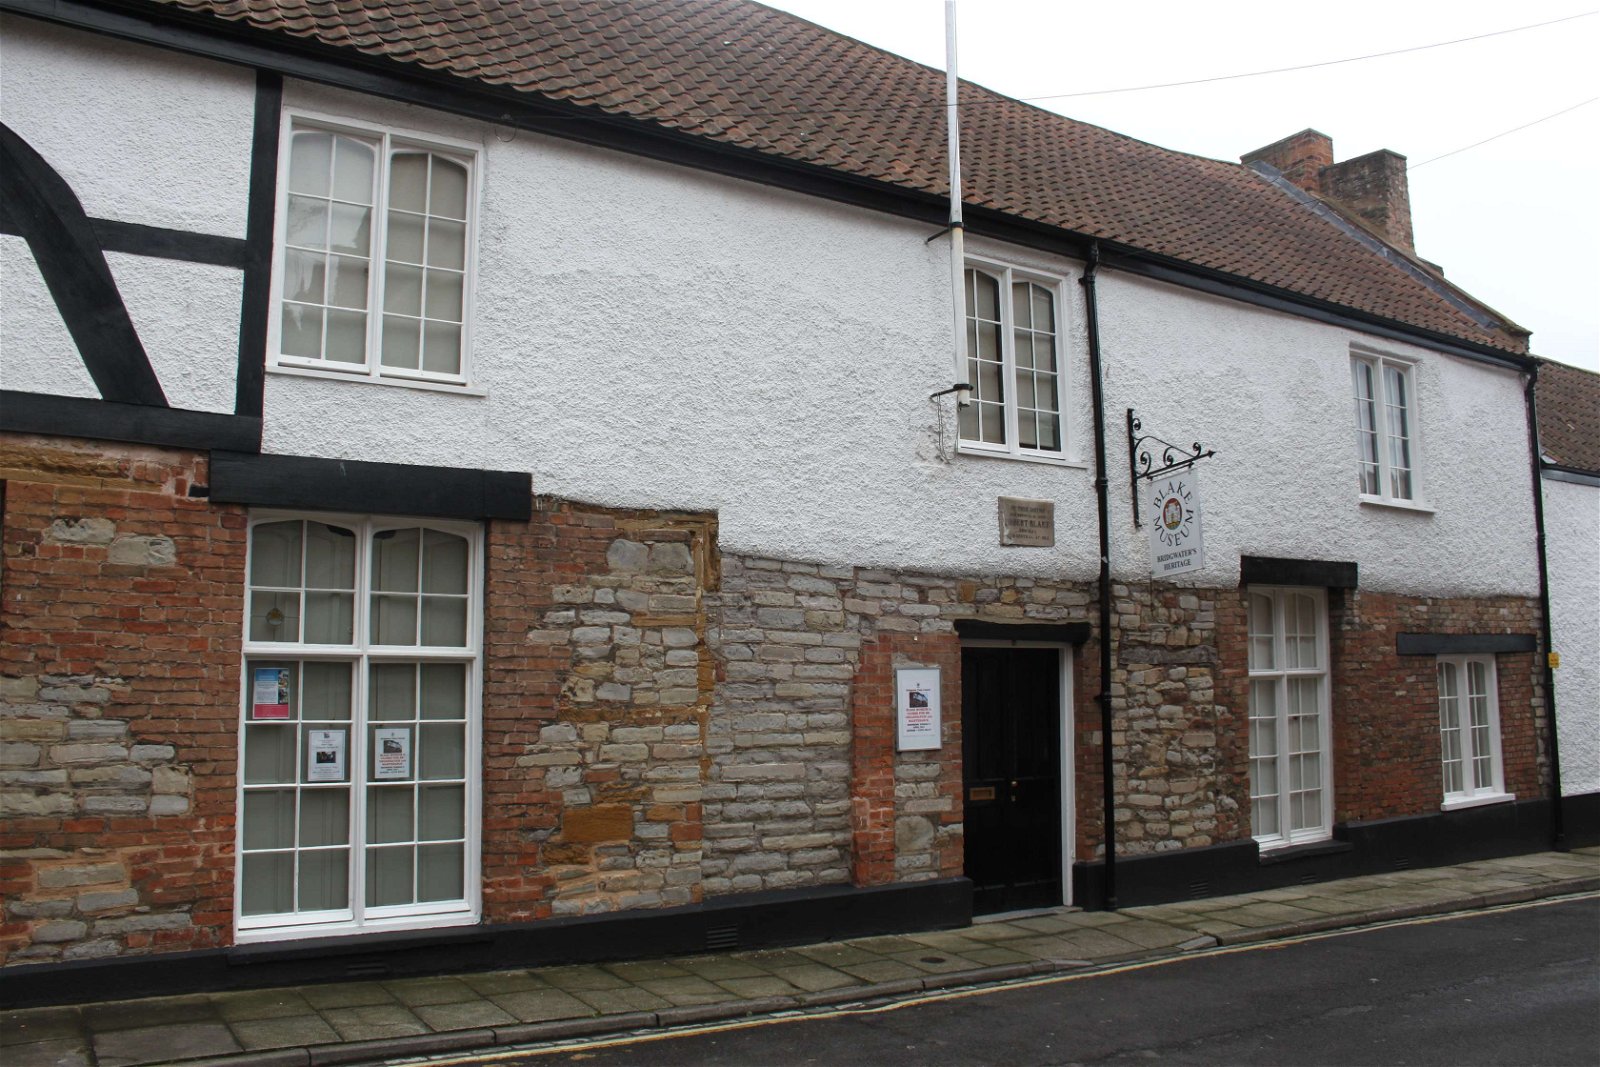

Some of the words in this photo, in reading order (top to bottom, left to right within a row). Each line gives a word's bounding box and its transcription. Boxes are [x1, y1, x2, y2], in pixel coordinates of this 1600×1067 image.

[1153, 481, 1193, 509] BLAKE
[1153, 509, 1194, 546] MUSEUM
[1157, 548, 1198, 563] BRIDGWATER'S
[1163, 558, 1192, 571] HERITAGE
